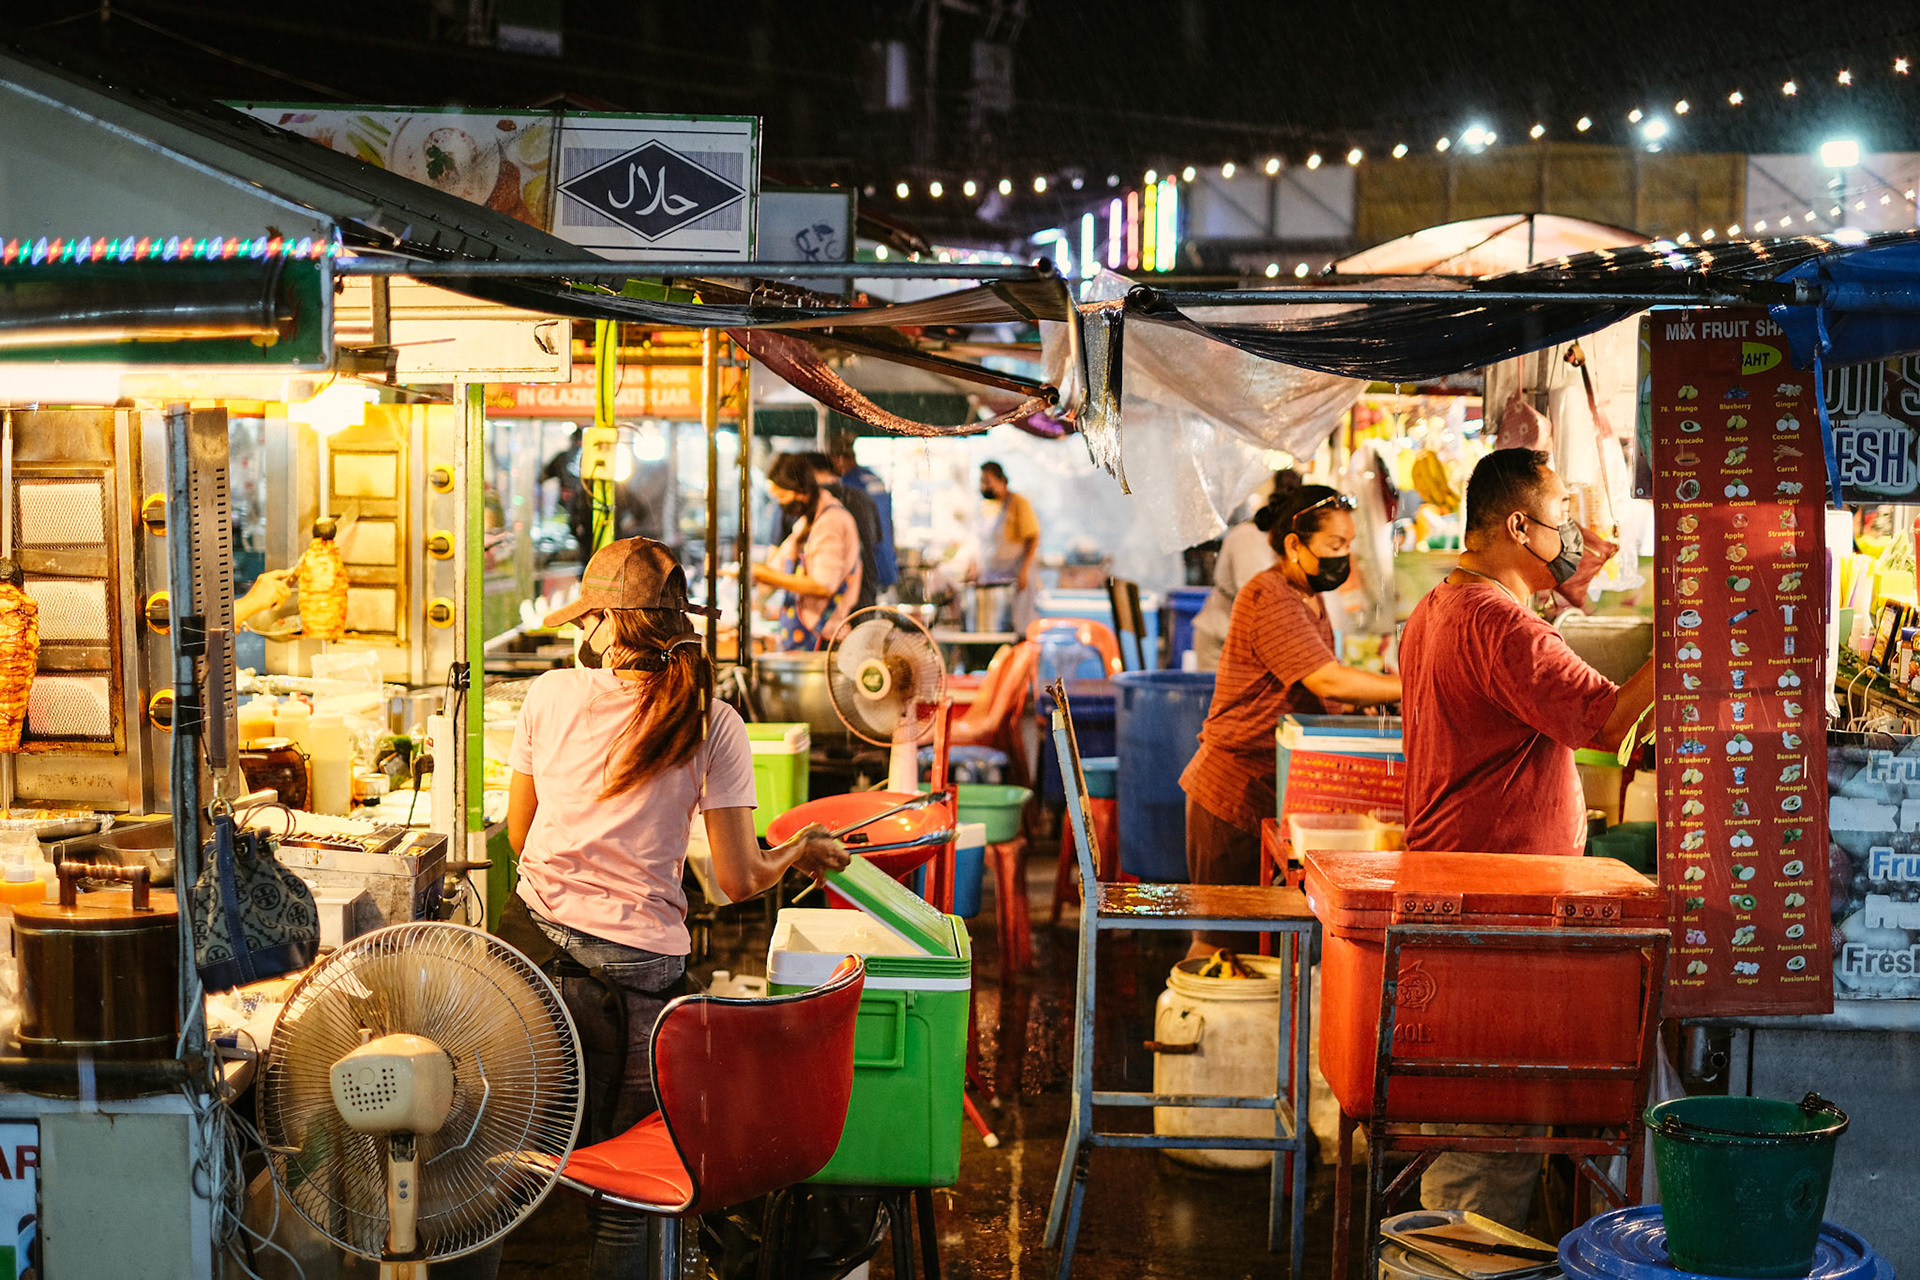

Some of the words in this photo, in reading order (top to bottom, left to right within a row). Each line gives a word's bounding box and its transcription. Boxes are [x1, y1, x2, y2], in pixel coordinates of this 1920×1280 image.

[607, 162, 699, 216] حلال
[1665, 322, 1696, 341] MIX
[1702, 320, 1749, 340] FRUIT
[1829, 428, 1909, 487] ESH
[1768, 530, 1804, 538] Strawberry
[1772, 562, 1808, 570] Strawberry
[1731, 723, 1753, 731] Yogurt
[1681, 947, 1713, 955] Raspberry
[1732, 945, 1764, 953] Pineapple
